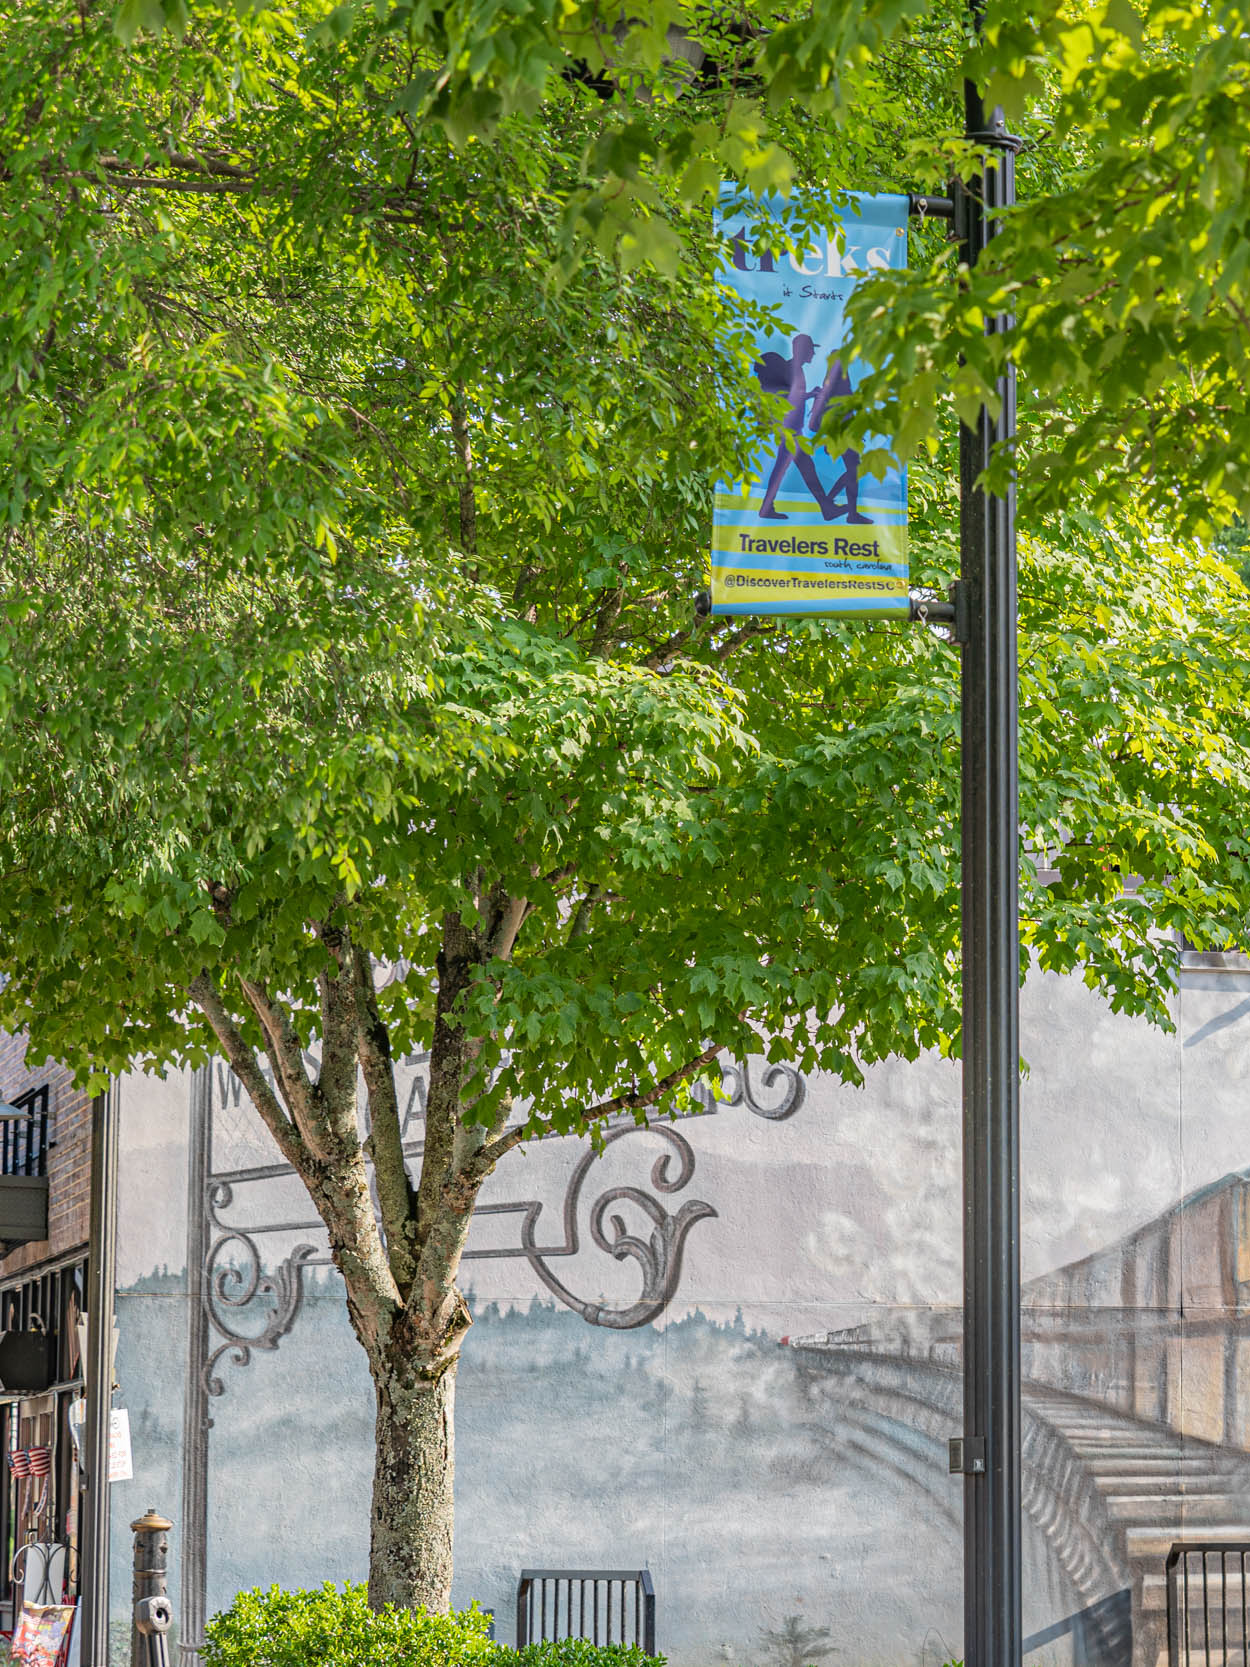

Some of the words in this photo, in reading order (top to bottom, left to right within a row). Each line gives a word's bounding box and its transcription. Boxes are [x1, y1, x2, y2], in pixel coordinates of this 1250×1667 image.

[783, 283, 792, 297] it
[799, 285, 844, 301] Starts
[739, 533, 829, 556] Travelers
[834, 537, 880, 558] Rest
[724, 574, 895, 591] @DiscoverTravelersRestSC
